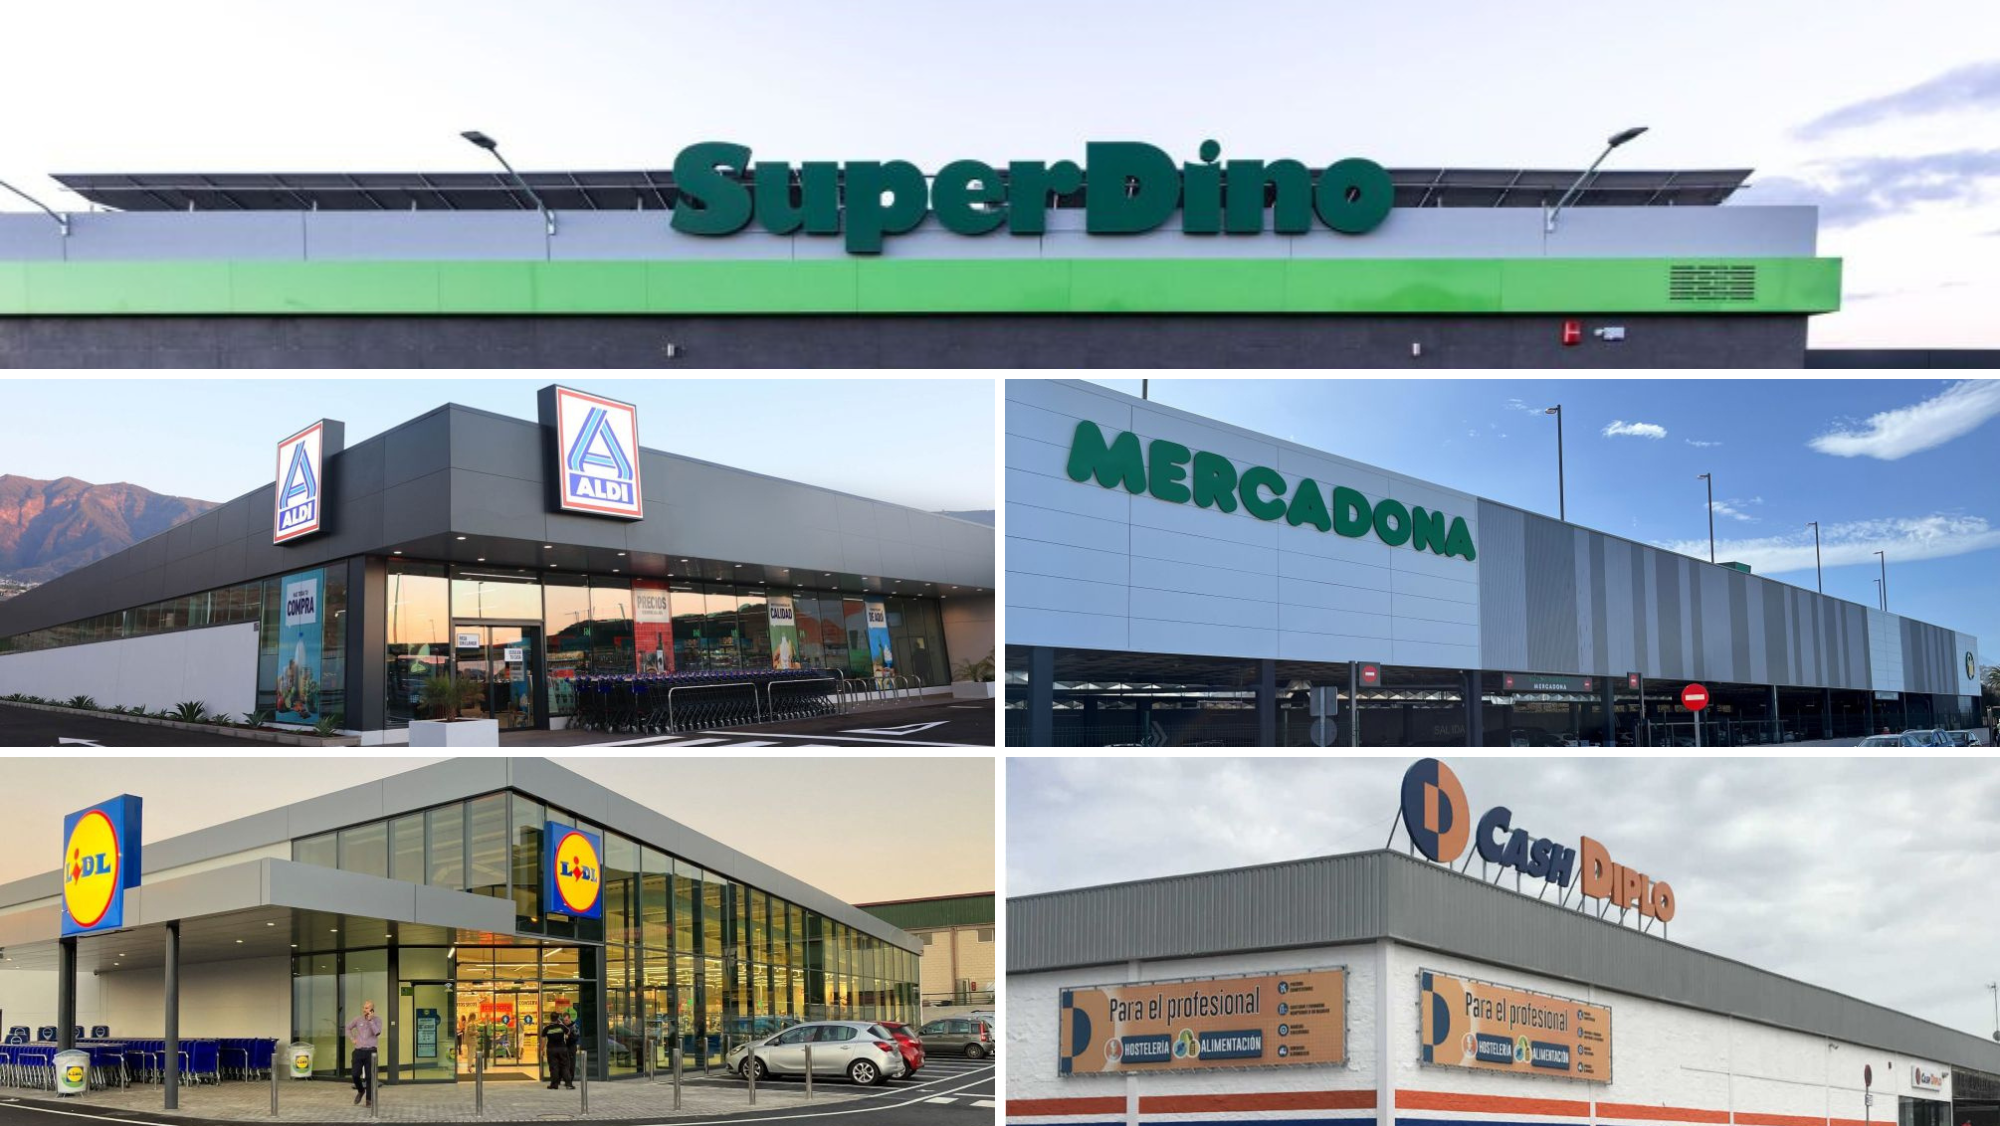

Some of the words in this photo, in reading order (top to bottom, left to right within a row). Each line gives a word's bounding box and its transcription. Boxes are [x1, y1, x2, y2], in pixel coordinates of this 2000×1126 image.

[669, 139, 1394, 255] SuperDino
[576, 476, 629, 502] ALDI
[1067, 420, 1477, 561] MERCADONA
[281, 502, 313, 529] ALDI
[287, 596, 315, 617] COMPRA
[637, 595, 667, 610] PRECIOS
[770, 607, 793, 619] CALIDAD
[1476, 806, 1576, 888] CASH
[1580, 835, 1675, 923] DIPLO
[1110, 998, 1143, 1022] Para
[1149, 994, 1162, 1019] el
[1168, 986, 1260, 1026] profesional
[1465, 992, 1493, 1019] Para
[1496, 998, 1506, 1022] el
[1510, 1003, 1568, 1031] profesional
[1124, 1040, 1170, 1056] HOSTELERÍA
[1201, 1036, 1262, 1052] ALIMENTACIÓN
[1478, 1041, 1513, 1057] HOSTELERÍA
[1532, 1047, 1569, 1064] ALIMENTACIÓN
